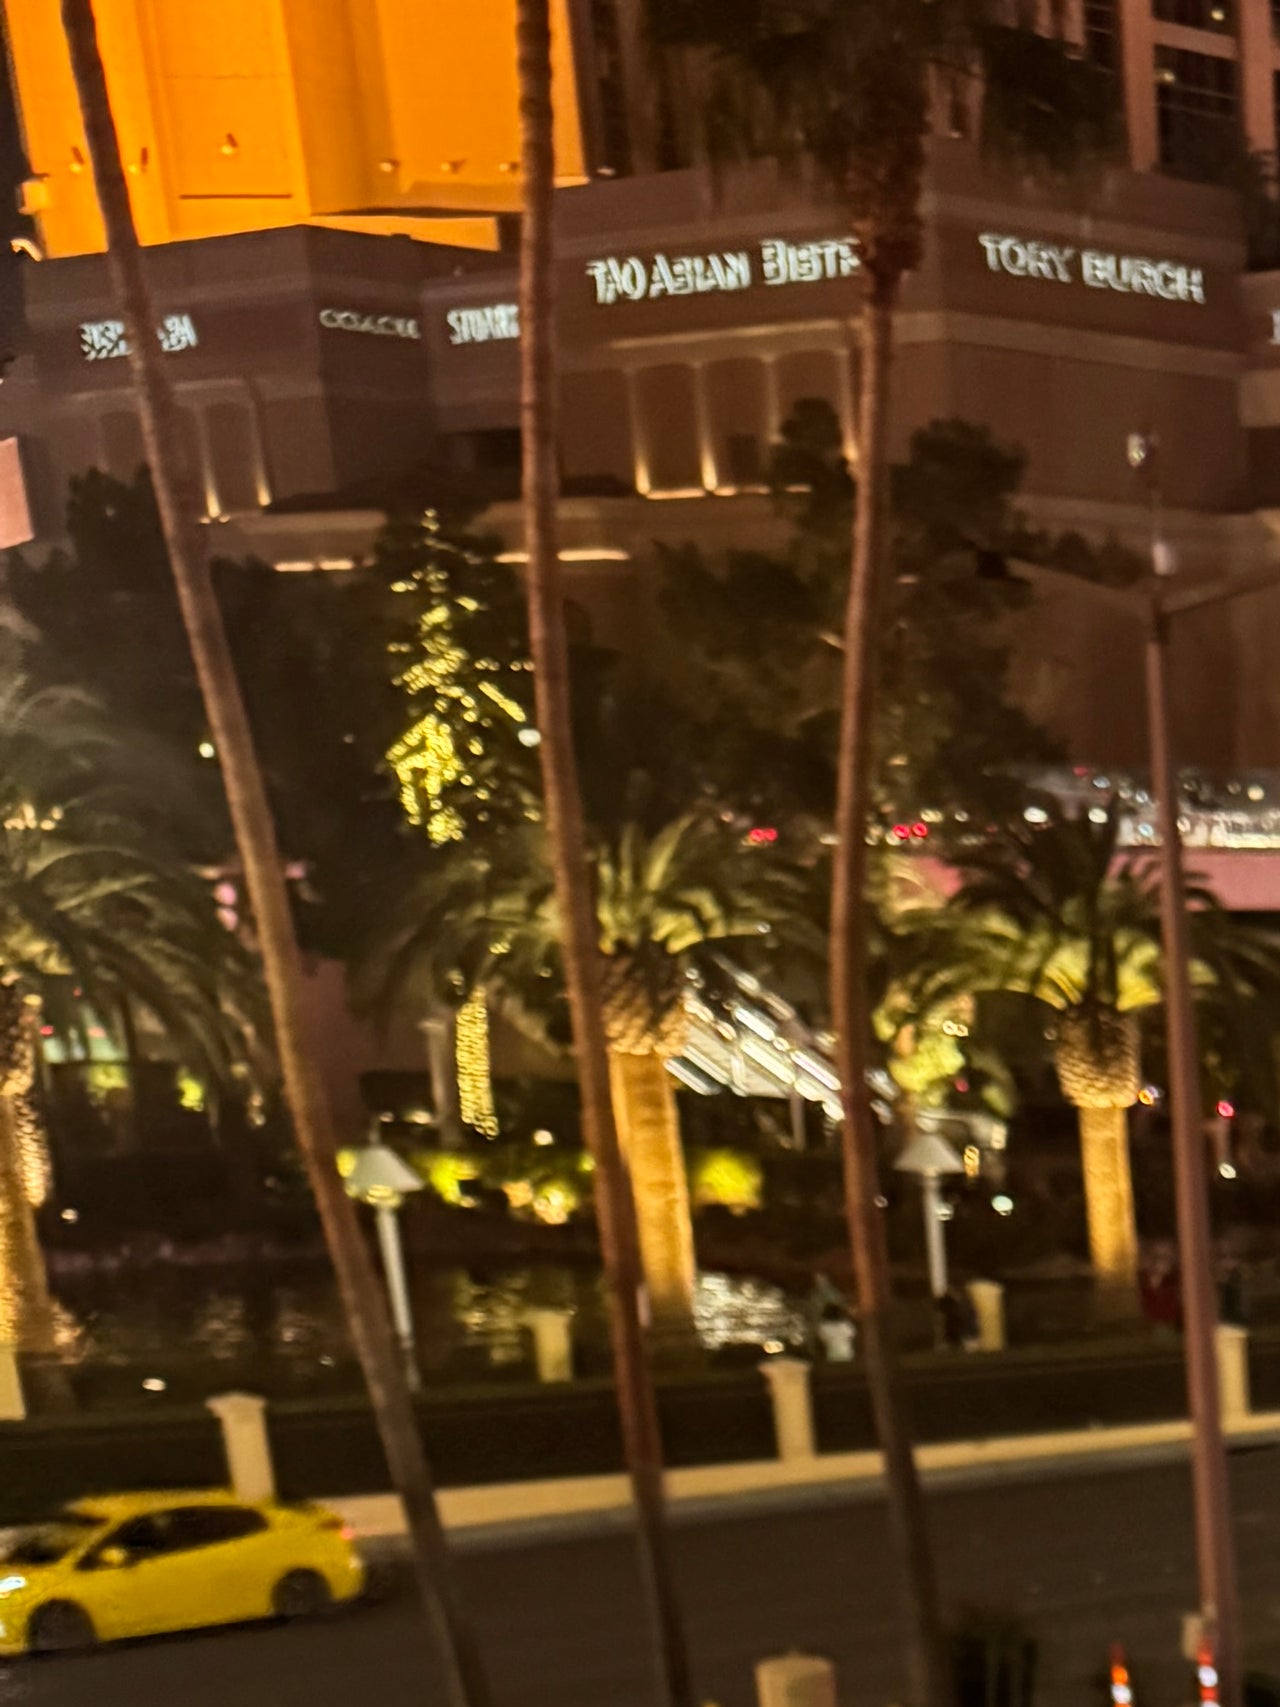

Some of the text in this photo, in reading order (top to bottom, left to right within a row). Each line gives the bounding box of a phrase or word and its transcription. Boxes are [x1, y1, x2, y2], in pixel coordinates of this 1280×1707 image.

[760, 237, 861, 286] BISTR
[978, 233, 1206, 304] TORY BURCH
